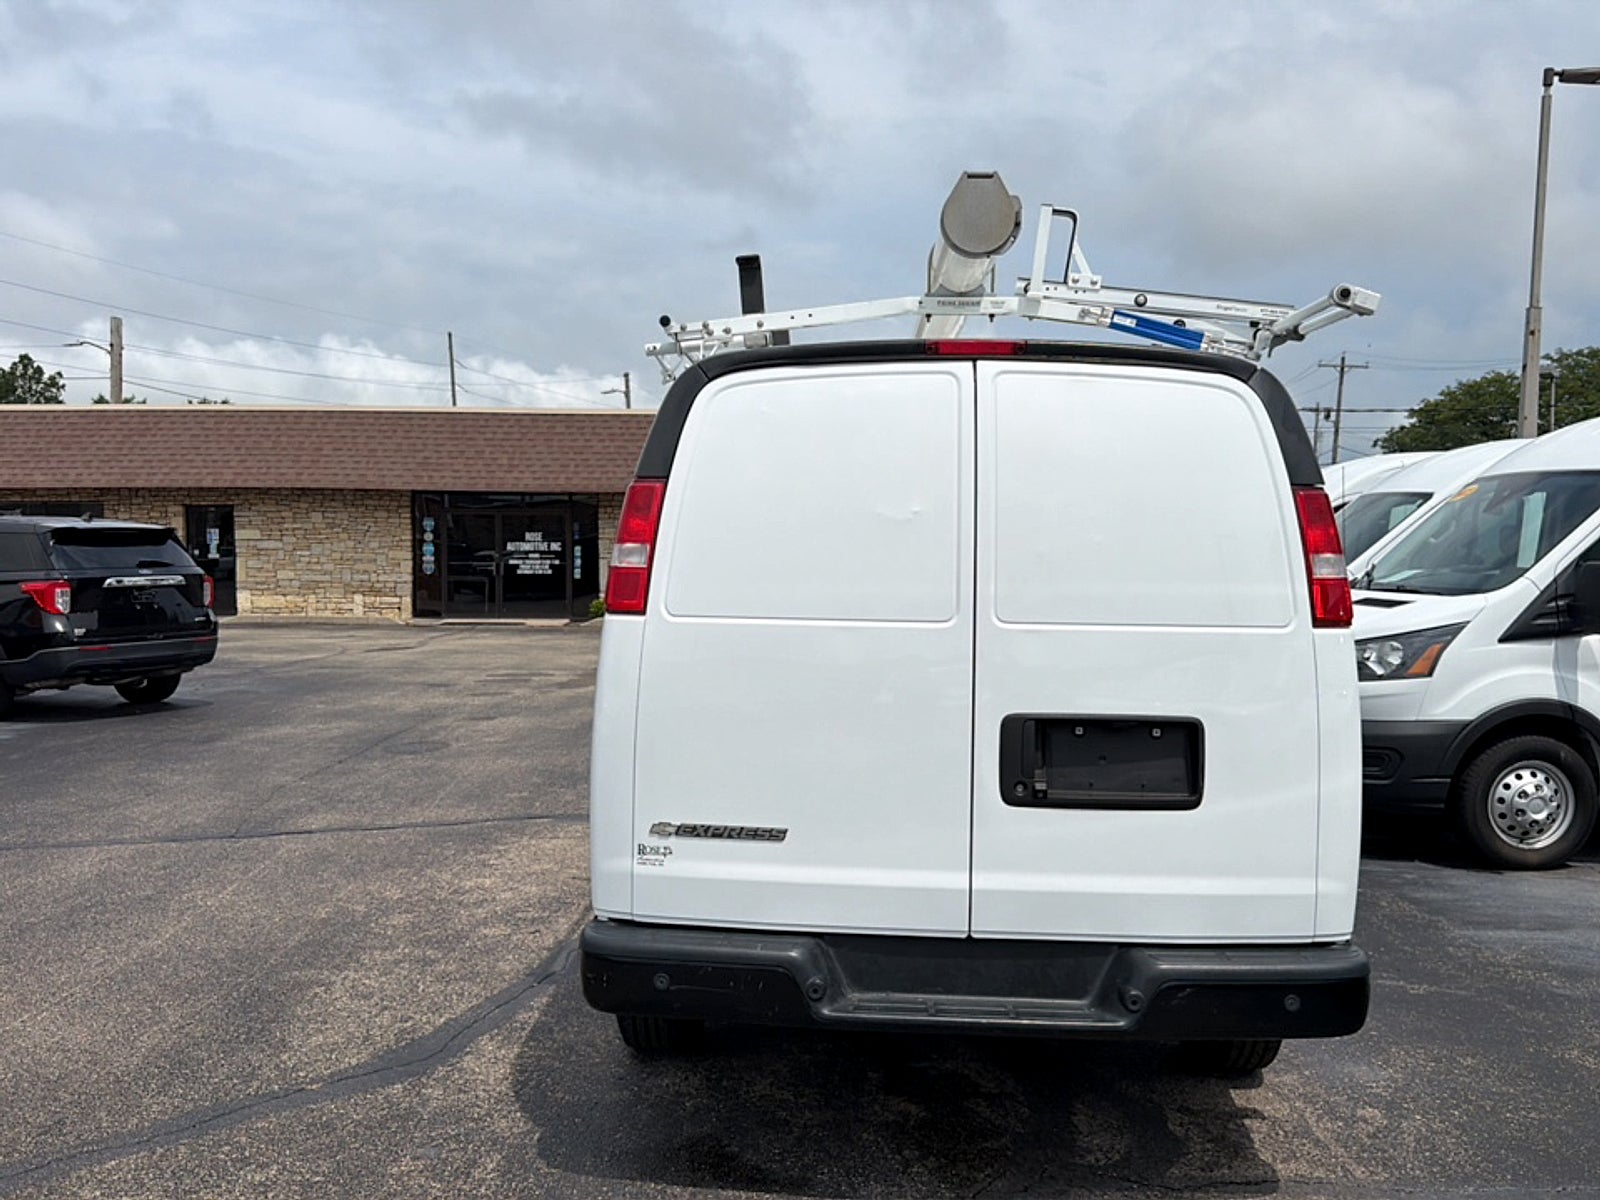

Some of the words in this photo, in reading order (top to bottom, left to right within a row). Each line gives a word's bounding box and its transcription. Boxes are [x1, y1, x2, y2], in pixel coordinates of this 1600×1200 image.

[525, 531, 543, 541] ROSE
[506, 541, 549, 551] AUTOMOTIVE
[550, 541, 562, 551] INC
[676, 823, 788, 841] EXPRESS
